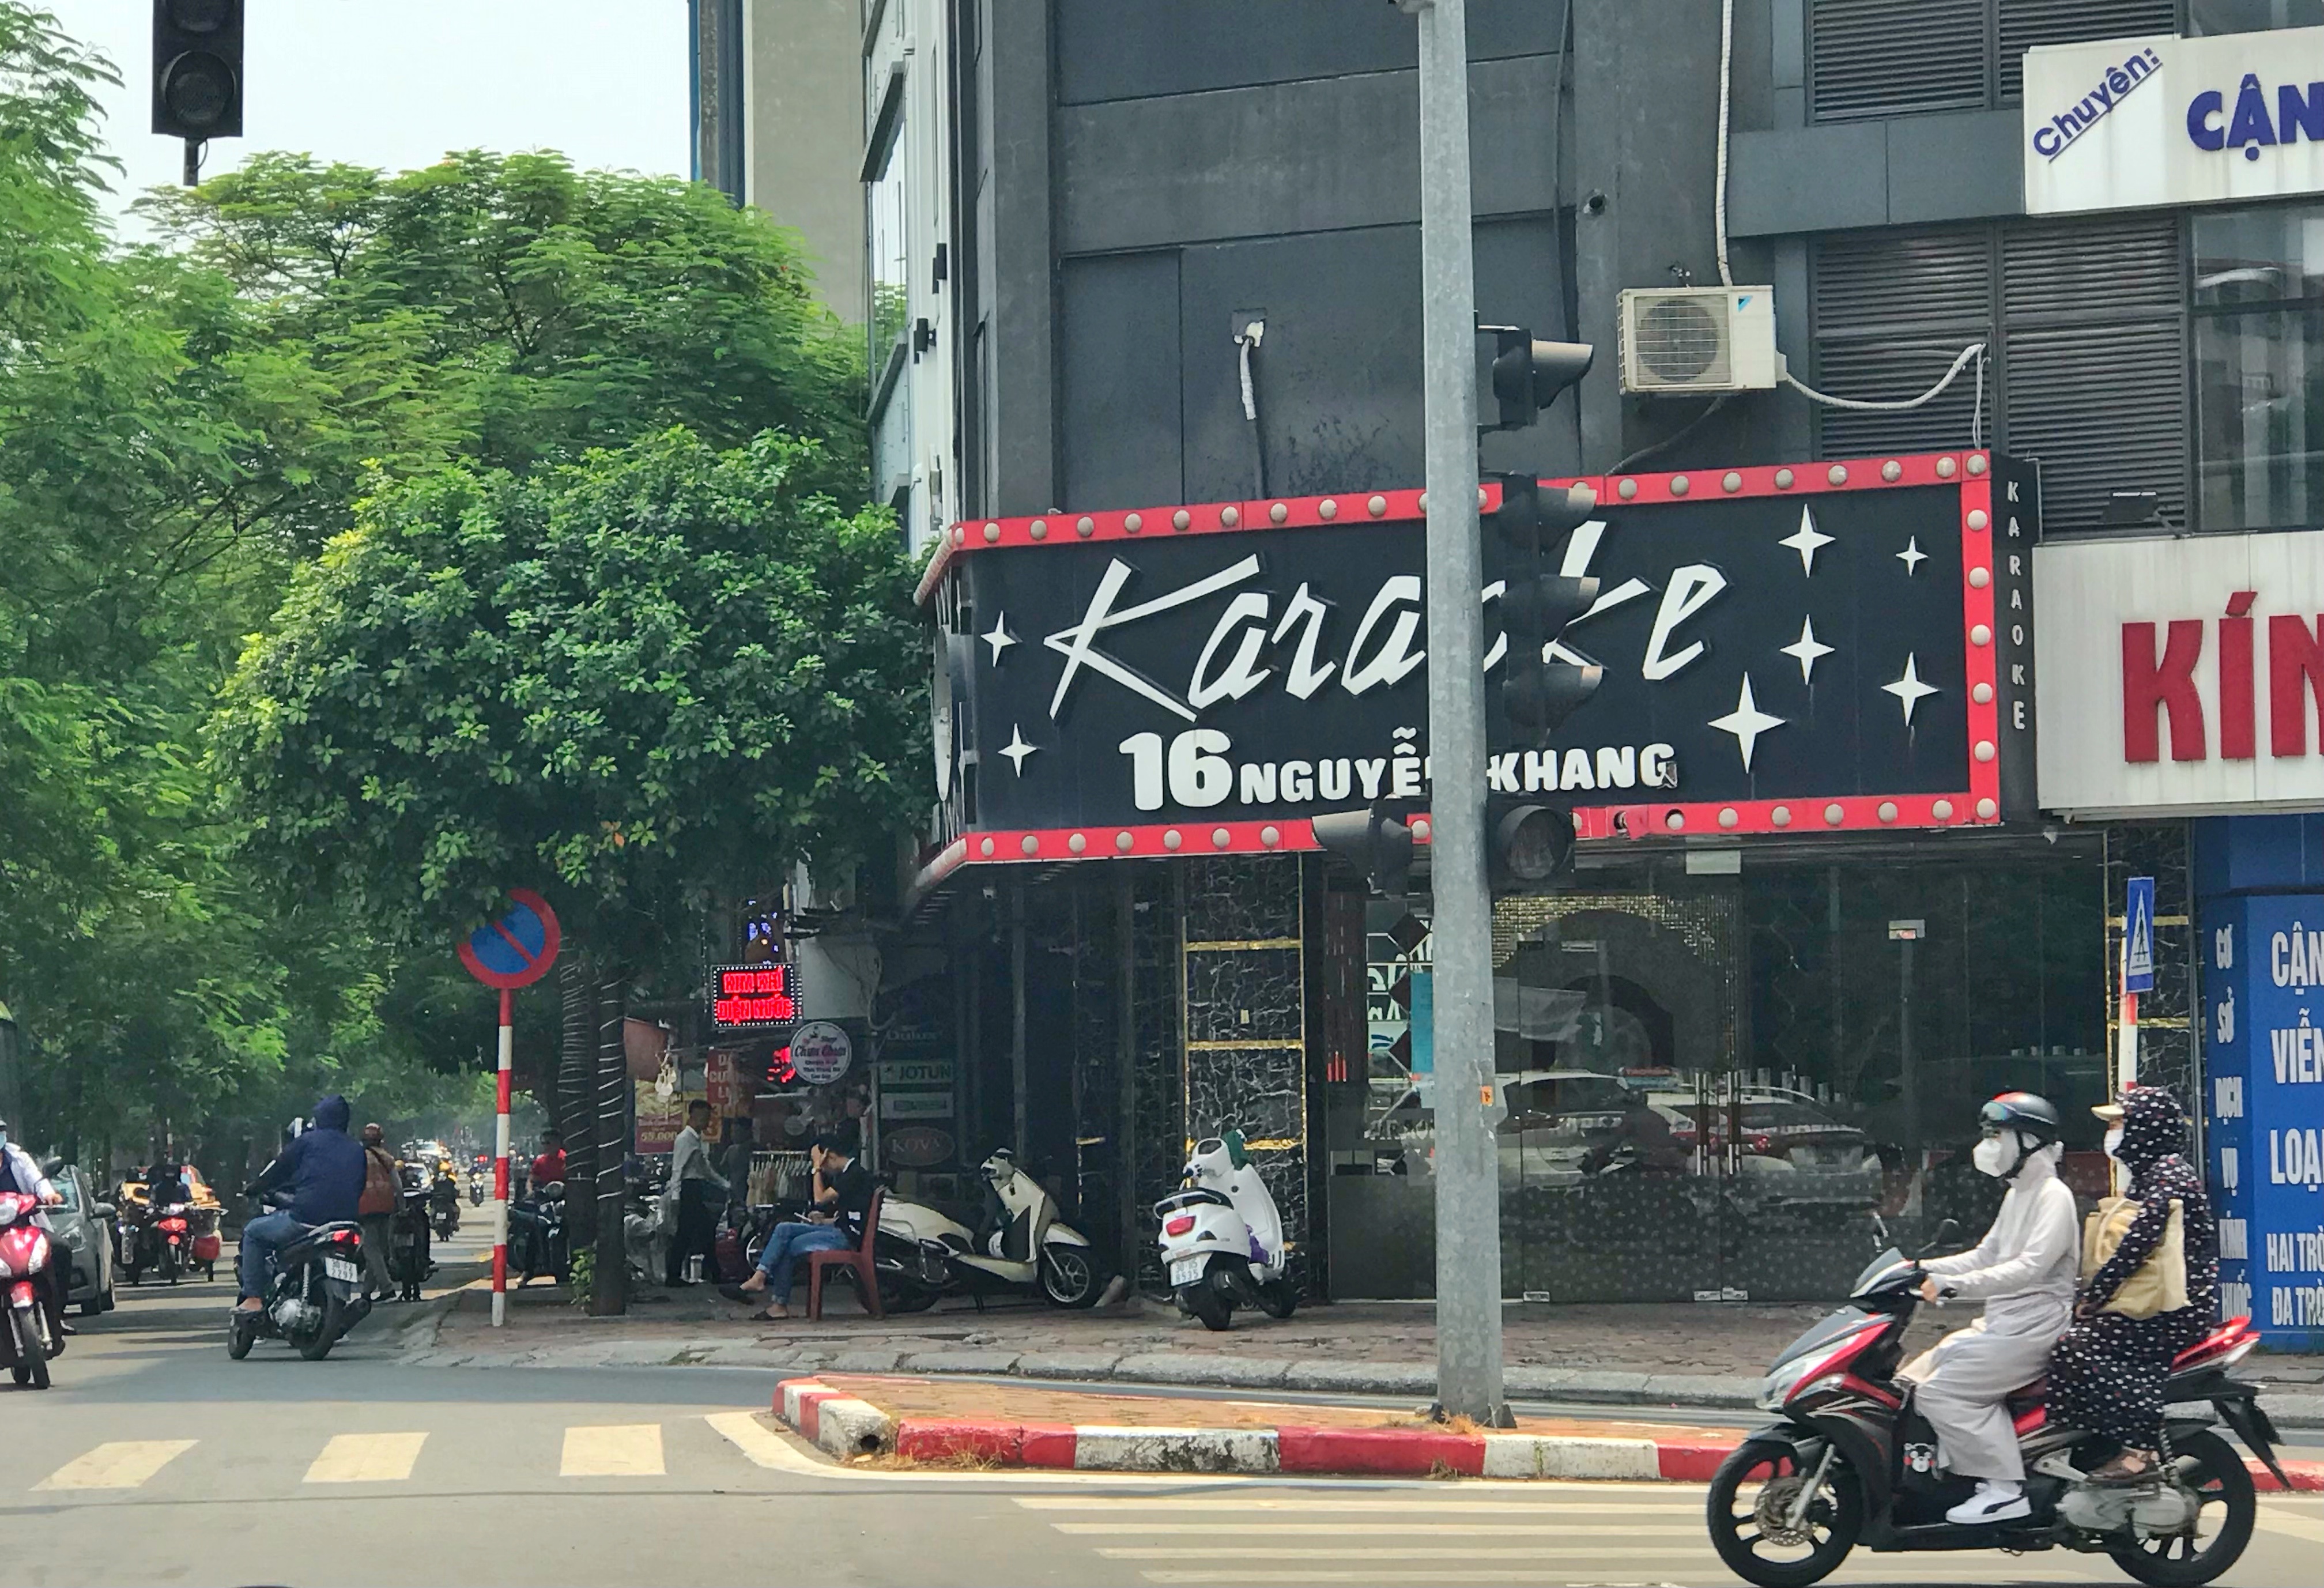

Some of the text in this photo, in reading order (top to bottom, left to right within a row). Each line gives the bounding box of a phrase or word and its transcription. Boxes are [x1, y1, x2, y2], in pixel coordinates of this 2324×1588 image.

[2033, 47, 2160, 156] Chuyên:
[2187, 73, 2324, 161] CẬN
[2007, 480, 2026, 731] KARAOKE
[1119, 727, 1678, 812] 16 NGUYỄ KHANG
[2216, 923, 2232, 969] CƠ
[2217, 986, 2234, 1043] SỞ
[899, 1065, 951, 1080] JOTUN
[2215, 1077, 2243, 1125] DỊCH
[2221, 1147, 2238, 1197] VỤ
[2266, 1233, 2295, 1272] HAI
[2218, 1268, 2253, 1322] HUỐC
